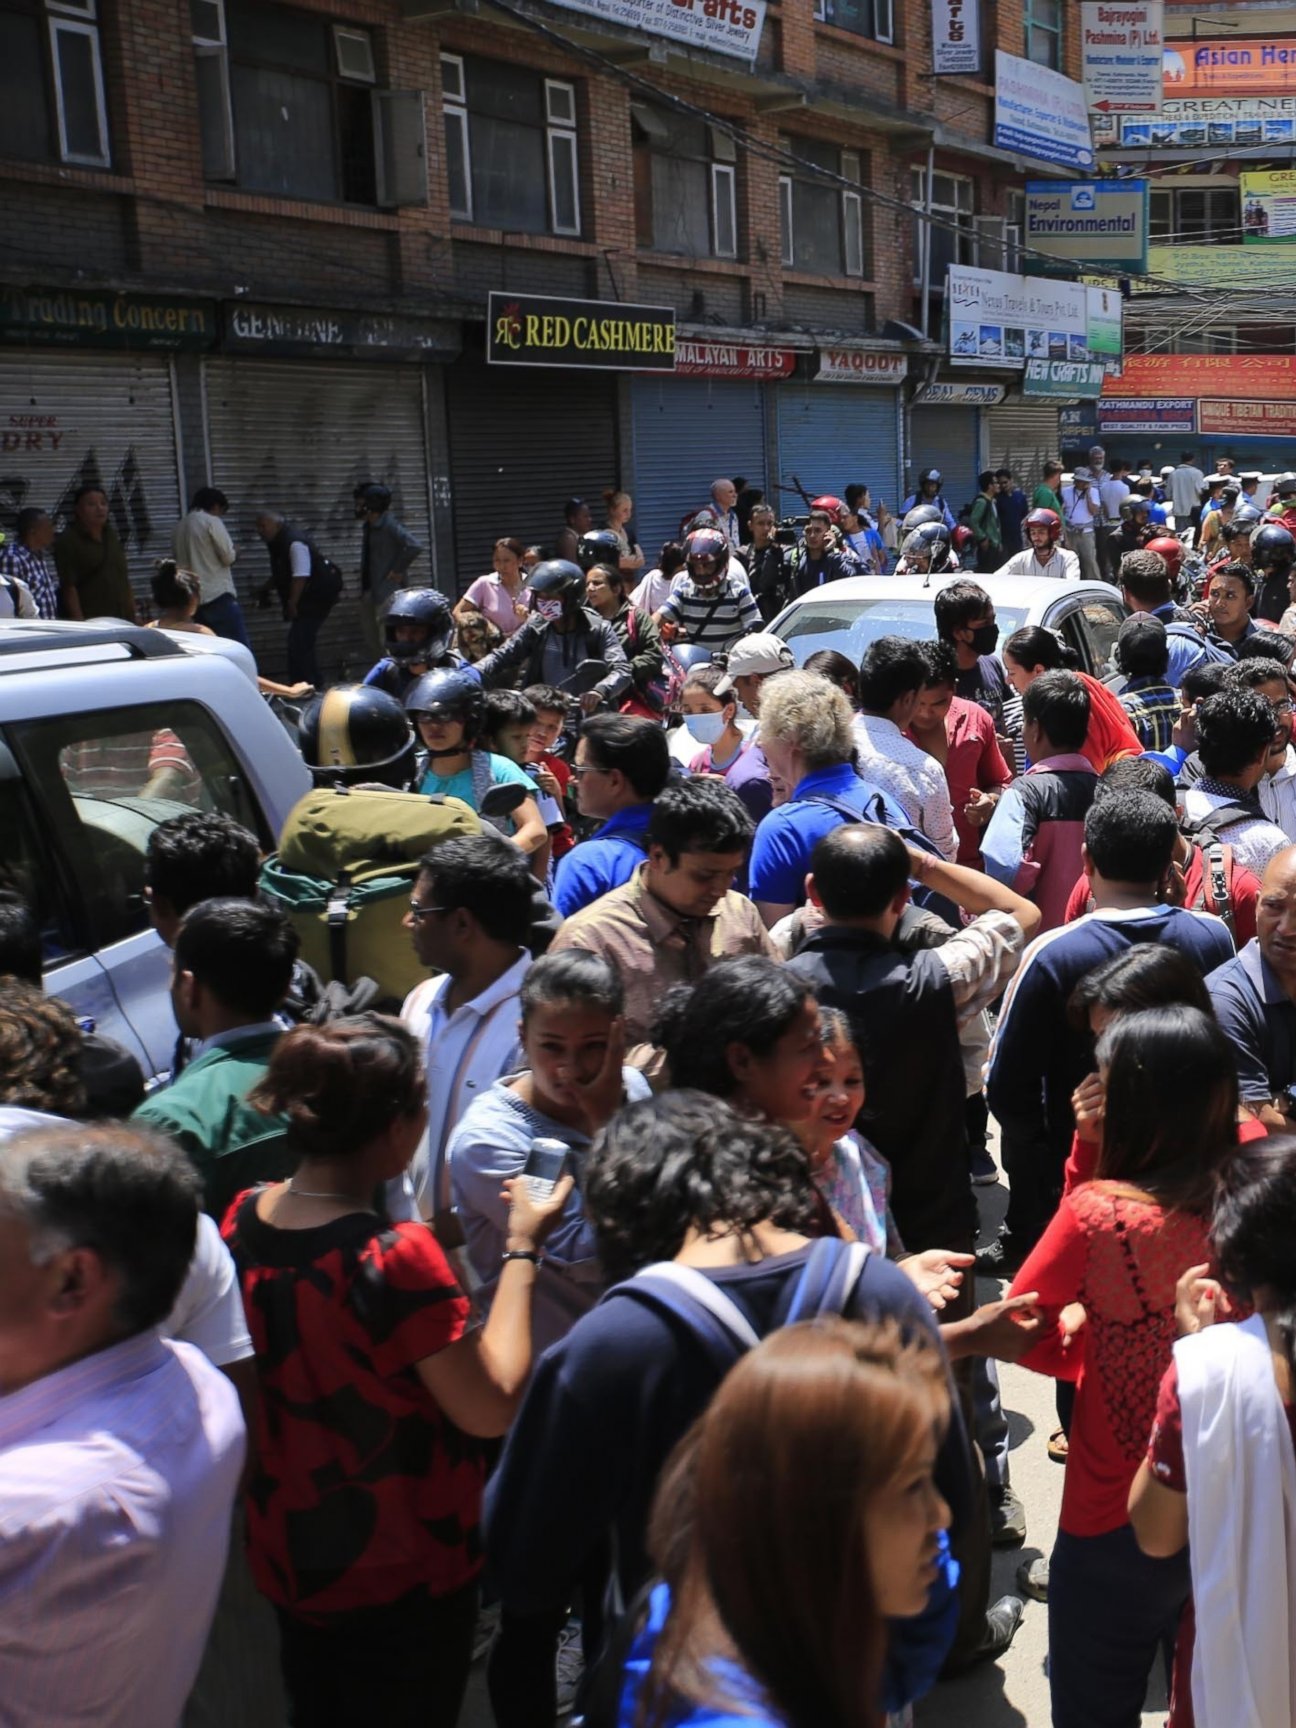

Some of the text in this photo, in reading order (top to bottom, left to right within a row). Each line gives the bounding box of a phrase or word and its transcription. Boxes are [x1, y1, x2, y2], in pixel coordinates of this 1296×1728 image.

[1085, 29, 1127, 45] Pashmina
[1195, 46, 1251, 66] Asian
[1162, 99, 1247, 113] GREAT
[1028, 199, 1060, 213] Nepal
[1028, 212, 1136, 232] Environmental
[113, 293, 206, 333] Concern
[525, 315, 676, 353] RED CASHMERE
[747, 350, 783, 368] ARTS
[828, 352, 904, 373] YAQOOT
[1026, 359, 1050, 380] NEW
[1050, 362, 1089, 383] CRAFTS
[1099, 400, 1193, 409] KATHMANDU EXPORT
[1231, 403, 1263, 417] TIBETAN
[9, 416, 57, 428] SUPER
[1, 431, 63, 450] DRY
